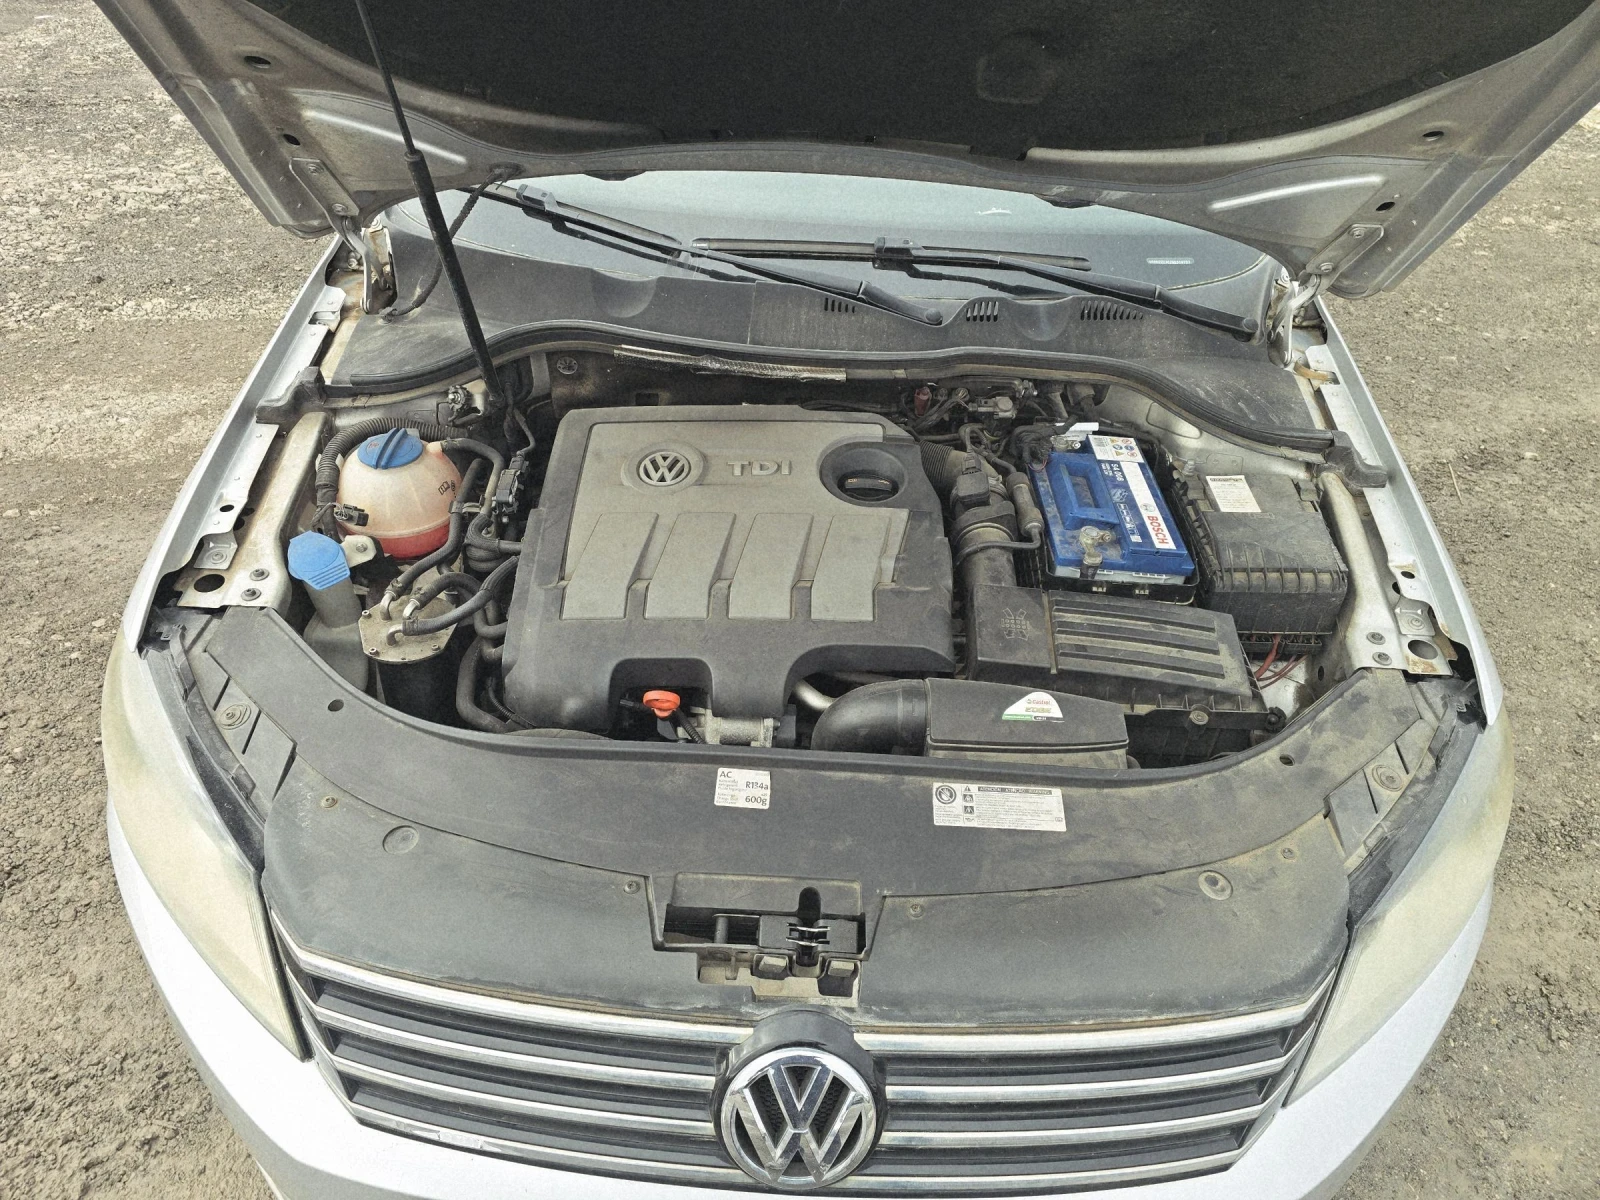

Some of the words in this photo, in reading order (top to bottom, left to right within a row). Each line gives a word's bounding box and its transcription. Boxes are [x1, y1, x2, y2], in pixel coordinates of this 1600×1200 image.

[727, 460, 792, 476] TDI
[1147, 515, 1170, 545] BOSCH
[719, 770, 732, 778] AC
[745, 780, 769, 791] R134a
[745, 796, 767, 806] 600g
